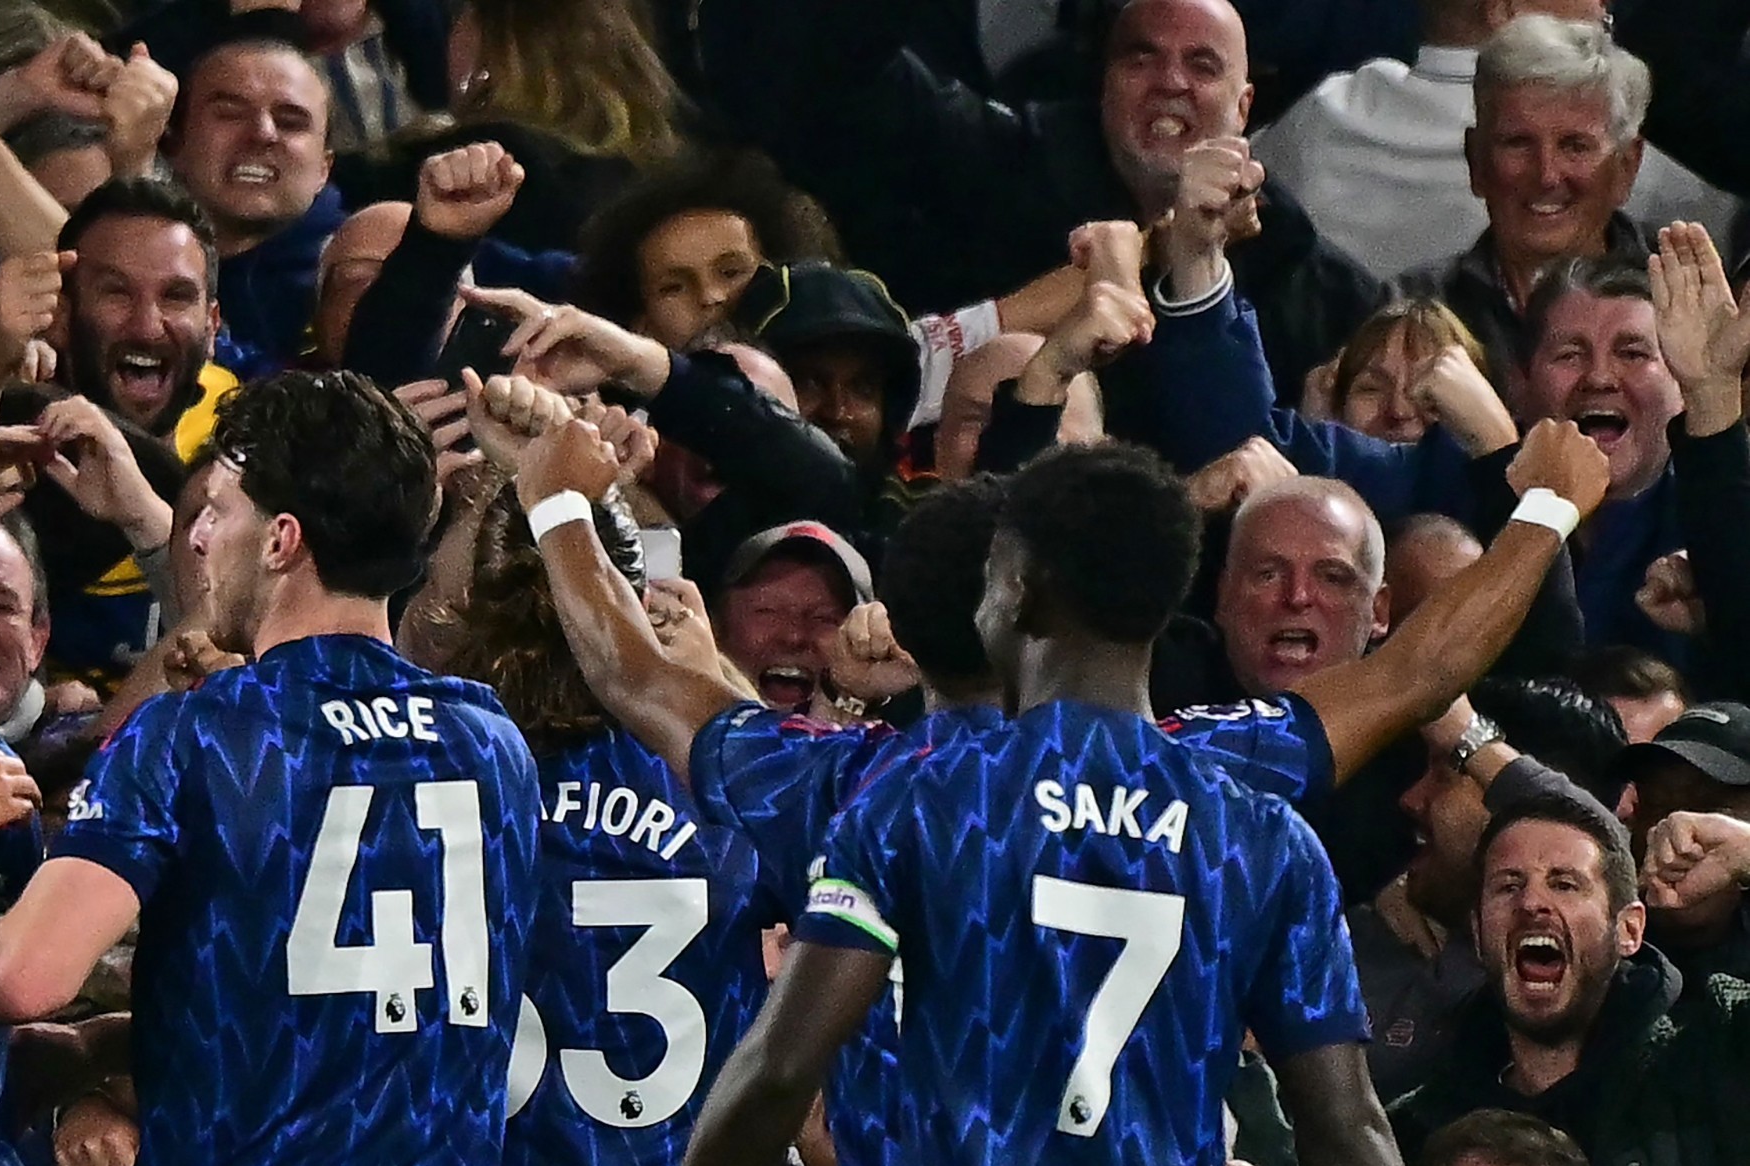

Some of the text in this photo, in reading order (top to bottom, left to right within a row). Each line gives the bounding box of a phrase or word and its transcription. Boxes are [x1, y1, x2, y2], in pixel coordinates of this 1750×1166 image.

[320, 696, 439, 745] RICE
[540, 781, 698, 861] FIORI
[1034, 779, 1189, 854] SAKA
[286, 779, 489, 1034] 41
[506, 878, 709, 1128] 3
[1031, 874, 1186, 1137] 7
